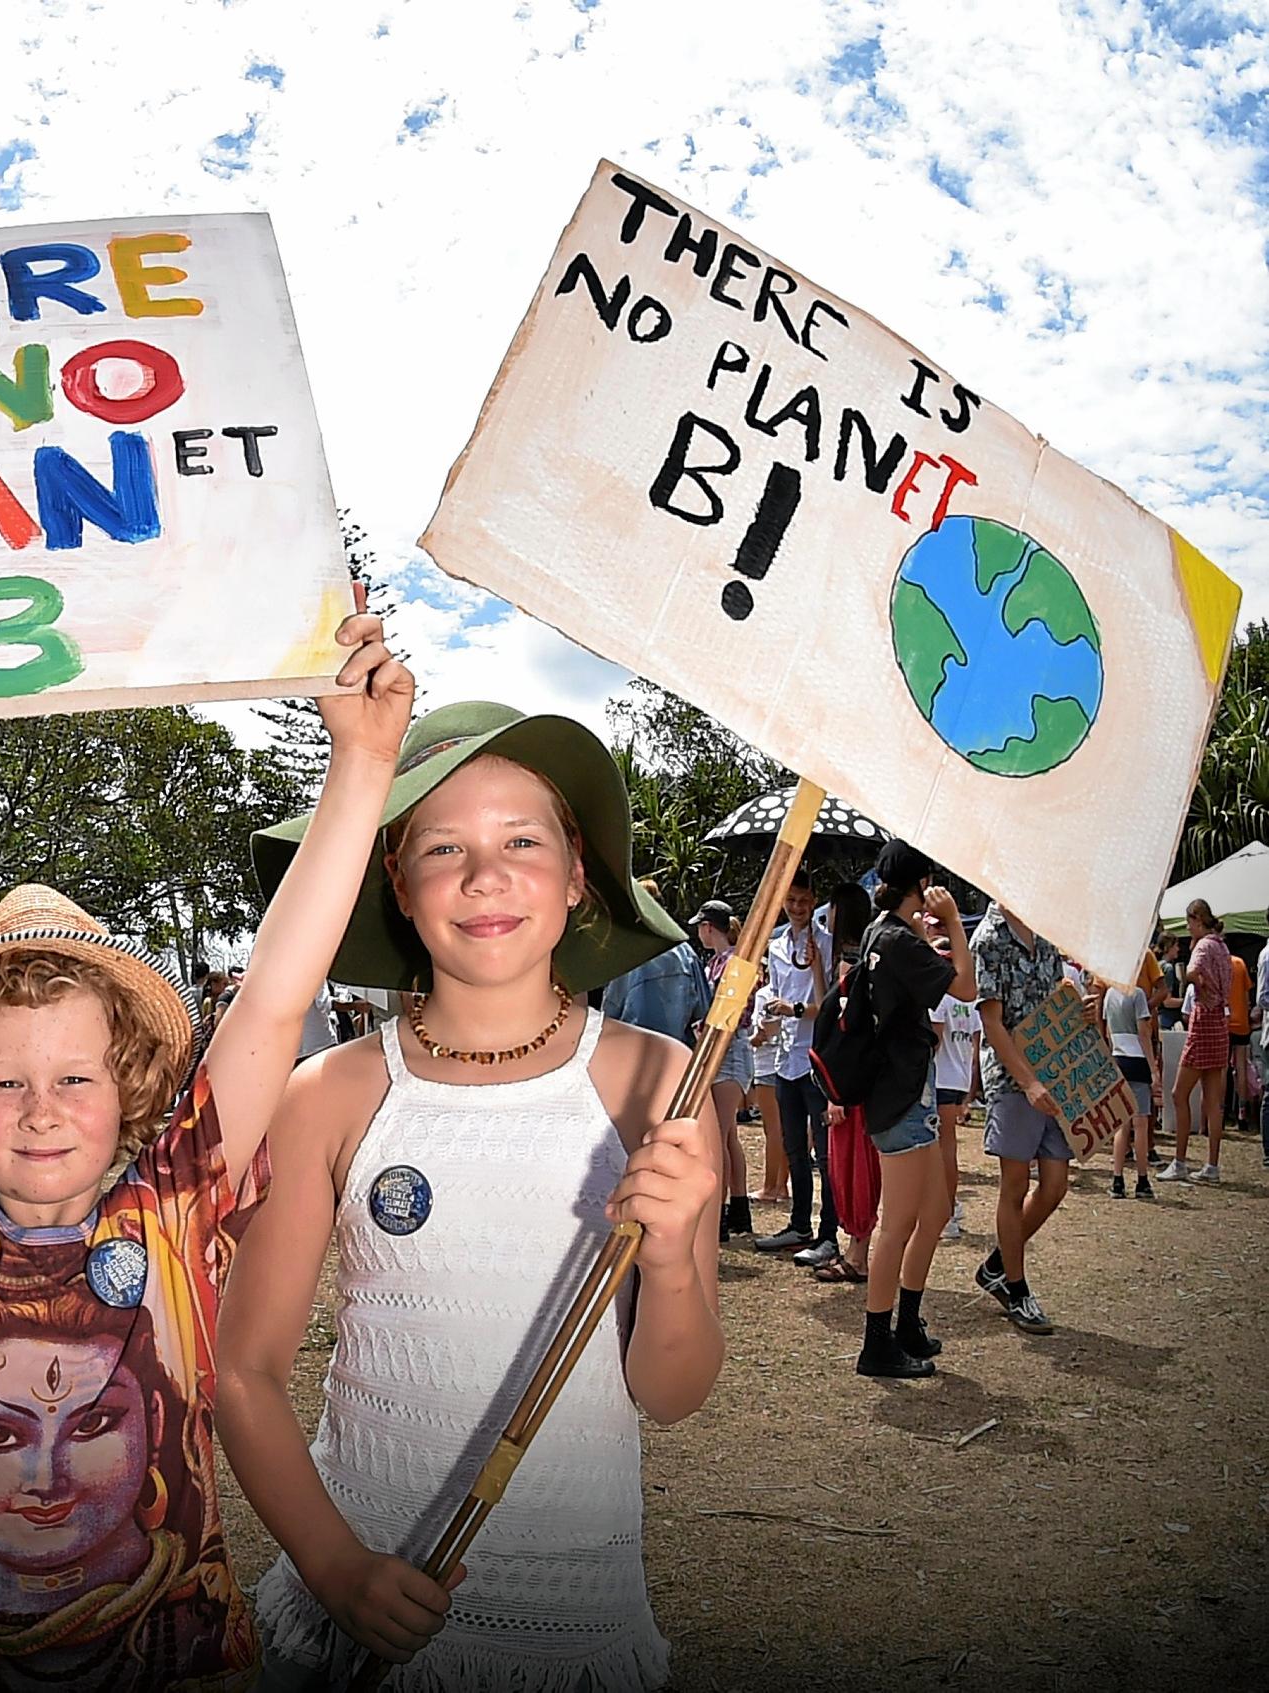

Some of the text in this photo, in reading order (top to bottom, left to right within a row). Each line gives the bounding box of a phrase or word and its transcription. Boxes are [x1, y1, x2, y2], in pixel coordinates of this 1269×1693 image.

[554, 252, 979, 533] NO PLANET
[608, 171, 982, 434] THERE IS
[1071, 1078, 1136, 1157] SHIT
